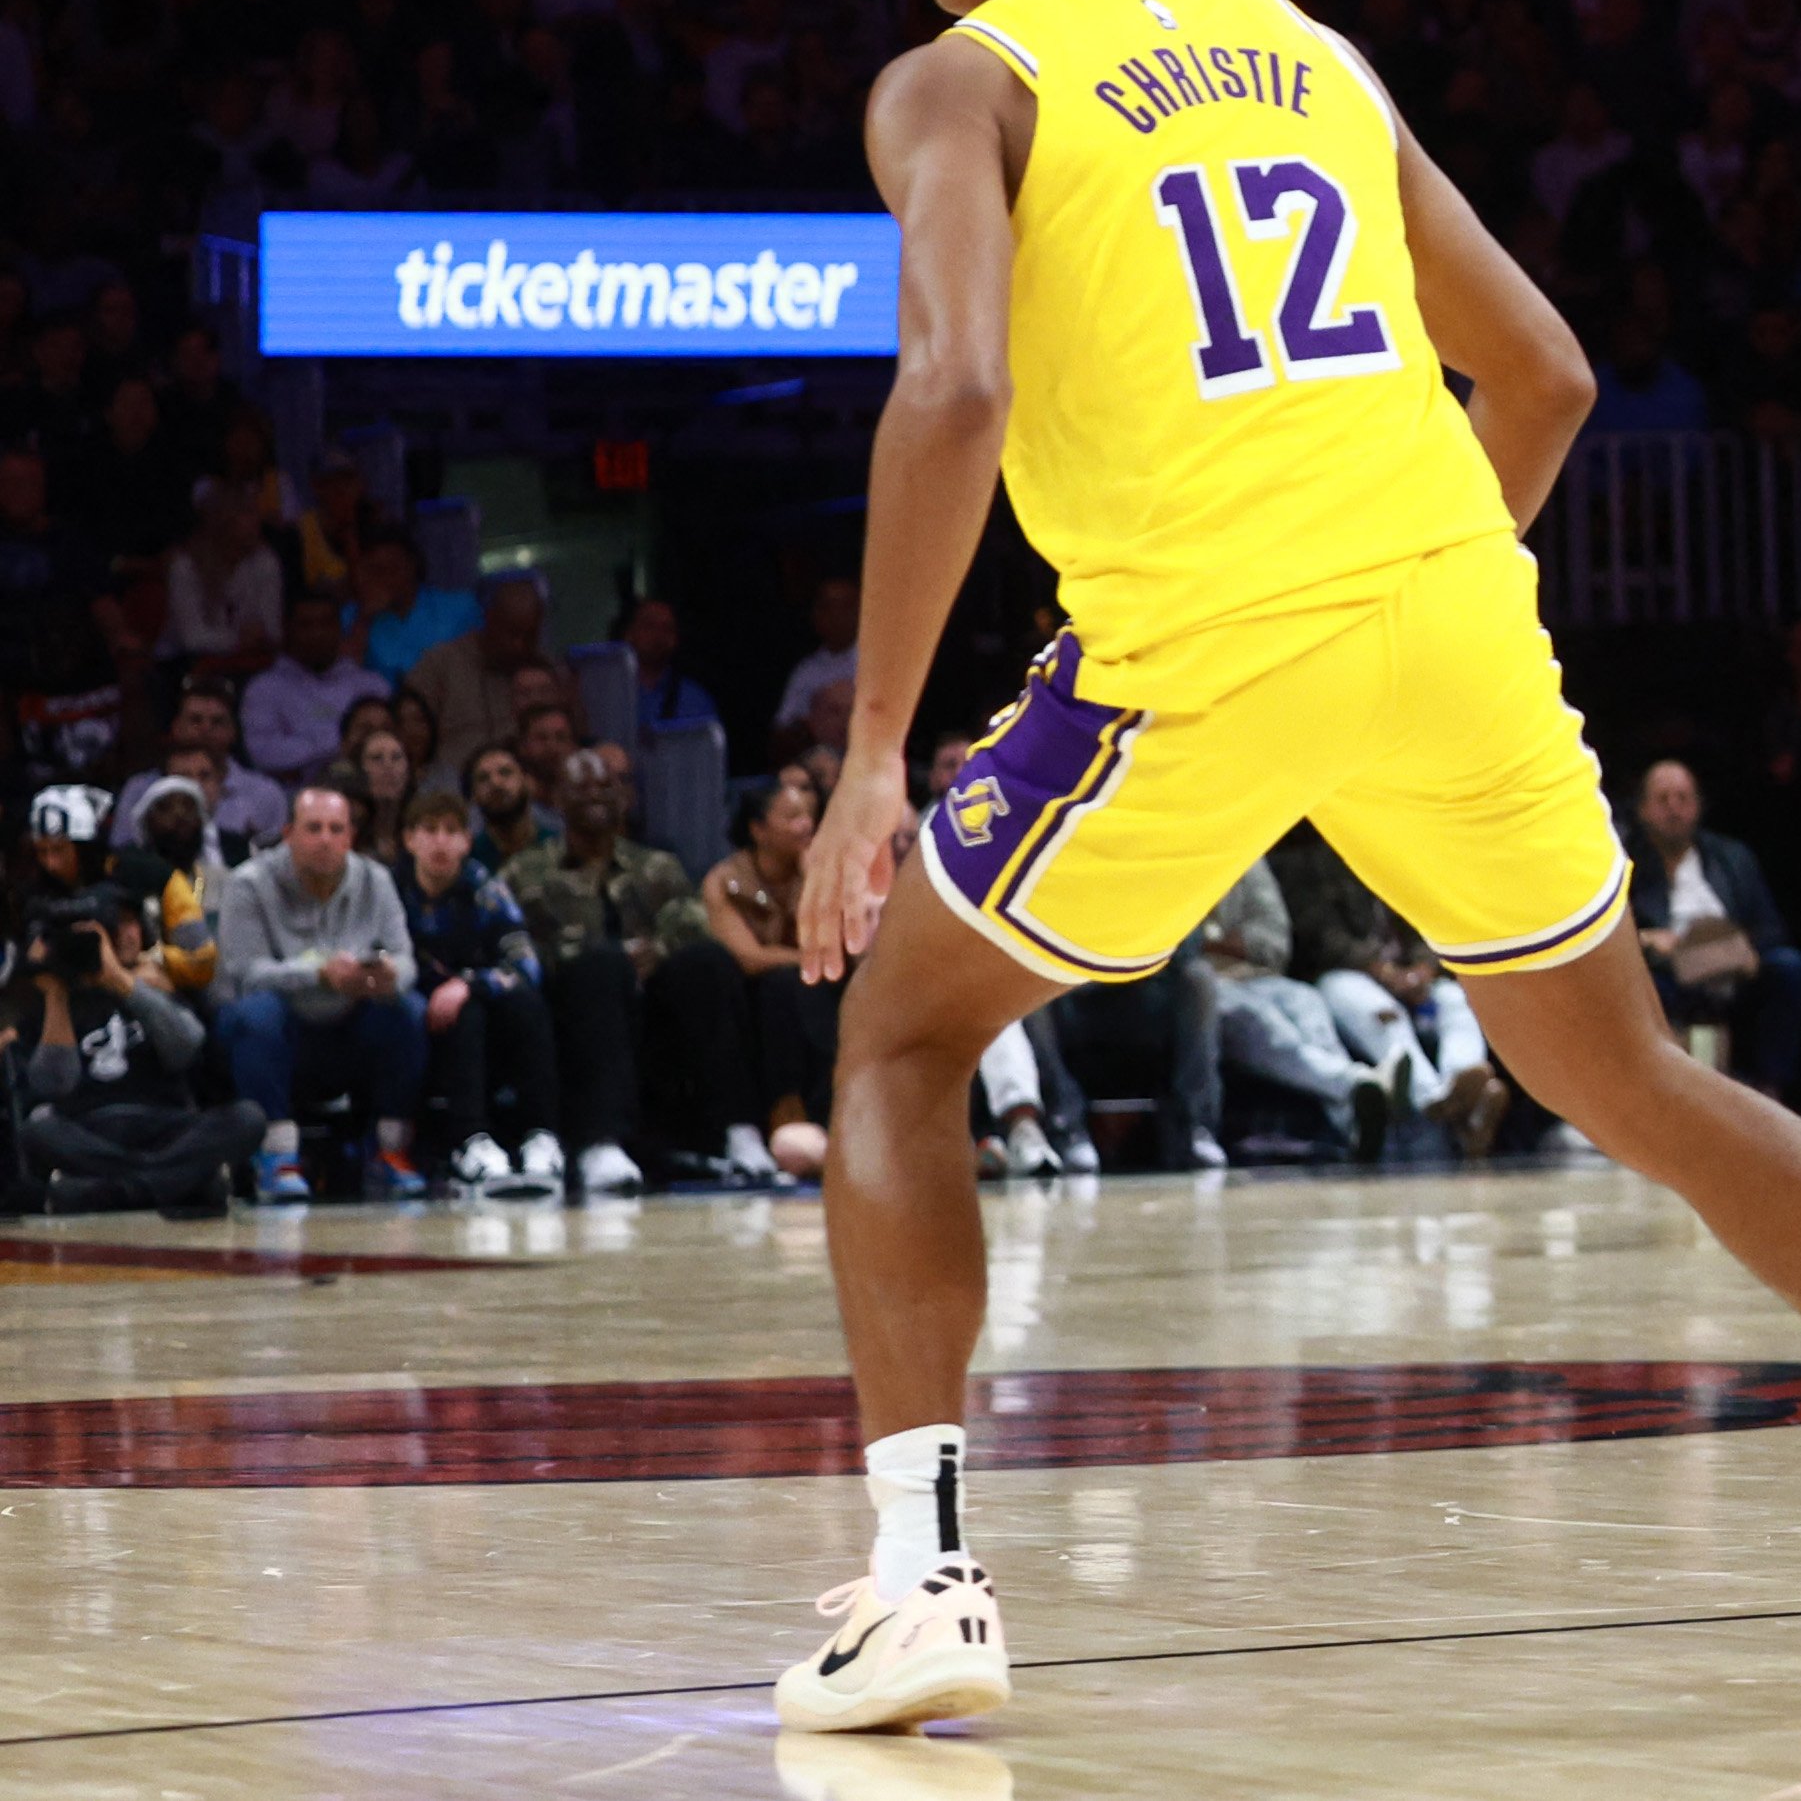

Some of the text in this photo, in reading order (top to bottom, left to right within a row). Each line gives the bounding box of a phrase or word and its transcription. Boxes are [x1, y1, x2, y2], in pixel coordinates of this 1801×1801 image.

[1094, 43, 1313, 134] CHRISTIE
[394, 238, 858, 330] ticketmaster
[1149, 153, 1402, 400] 12
